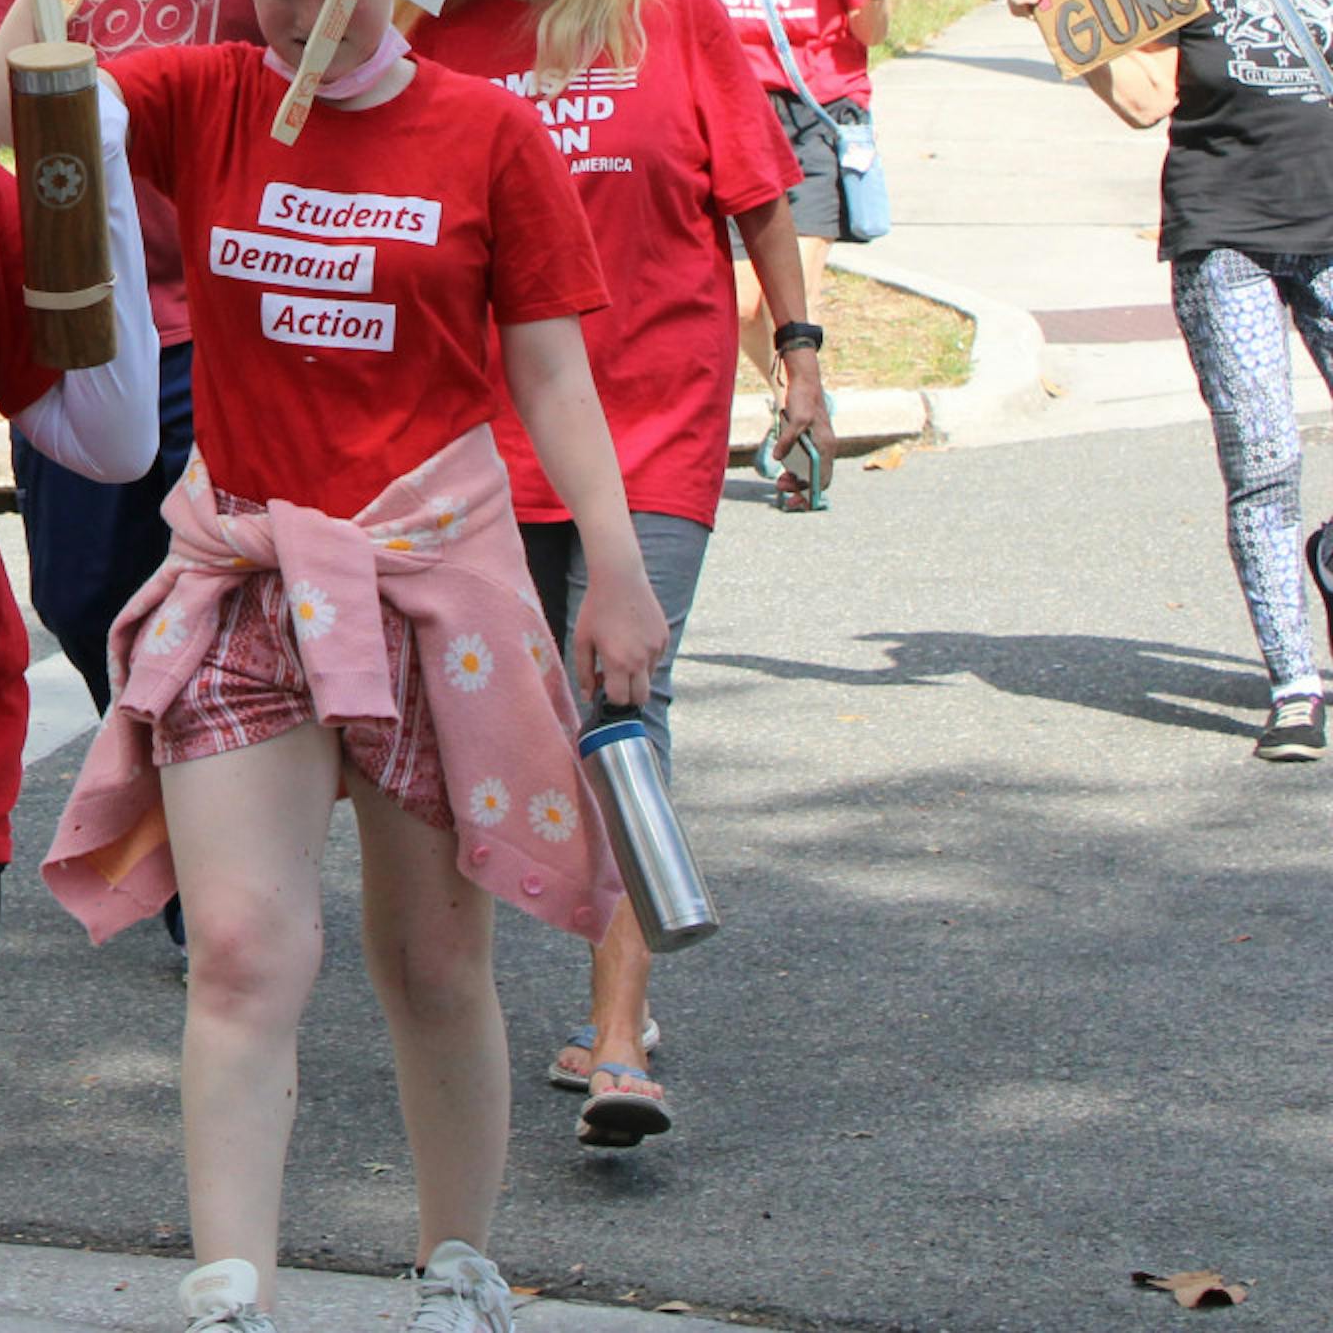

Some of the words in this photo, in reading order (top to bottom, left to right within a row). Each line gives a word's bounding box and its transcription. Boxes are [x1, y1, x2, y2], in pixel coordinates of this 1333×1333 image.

[275, 193, 426, 232] Students
[218, 238, 362, 281] Demand
[271, 304, 384, 341] Action
